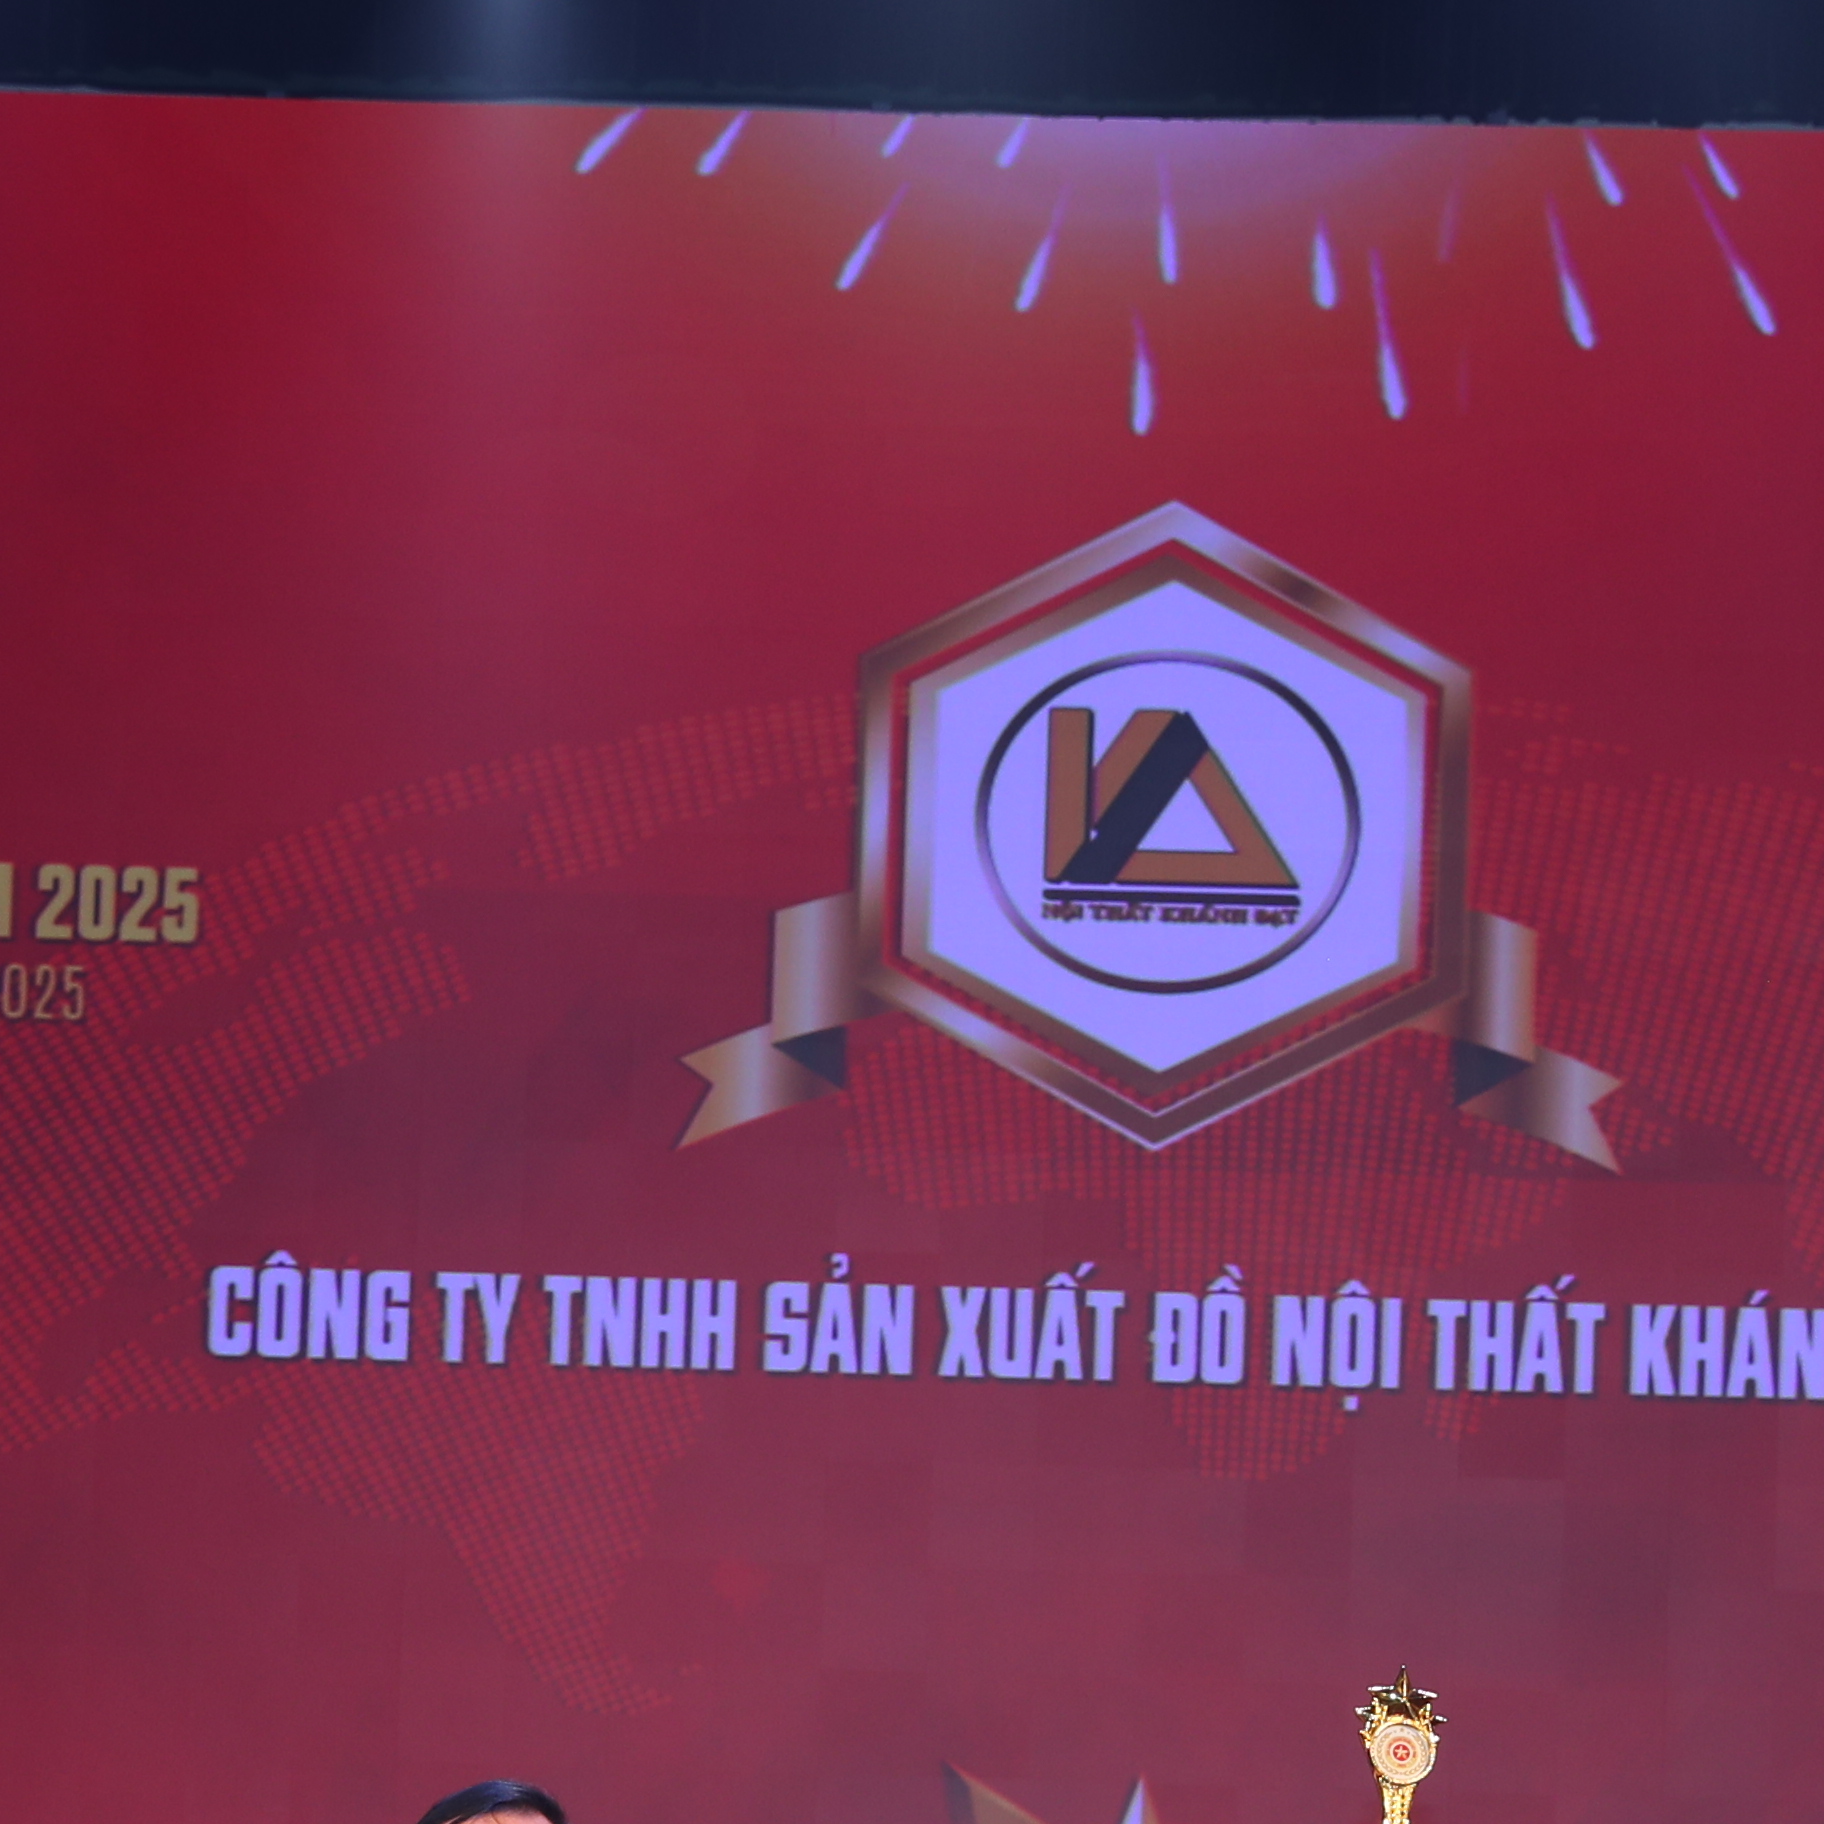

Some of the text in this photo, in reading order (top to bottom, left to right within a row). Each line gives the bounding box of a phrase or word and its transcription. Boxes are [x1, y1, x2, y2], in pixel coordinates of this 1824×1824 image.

[34, 863, 199, 944] 2025
[207, 1250, 411, 1362] CÔNG
[436, 1270, 521, 1366] TY
[543, 1274, 737, 1371] TNHH
[762, 1253, 915, 1377] SẢN
[938, 1261, 1126, 1382] XUẤT
[1150, 1264, 1246, 1386] ĐỒ
[1271, 1279, 1403, 1411] NỘI
[1427, 1274, 1606, 1396] THẤT
